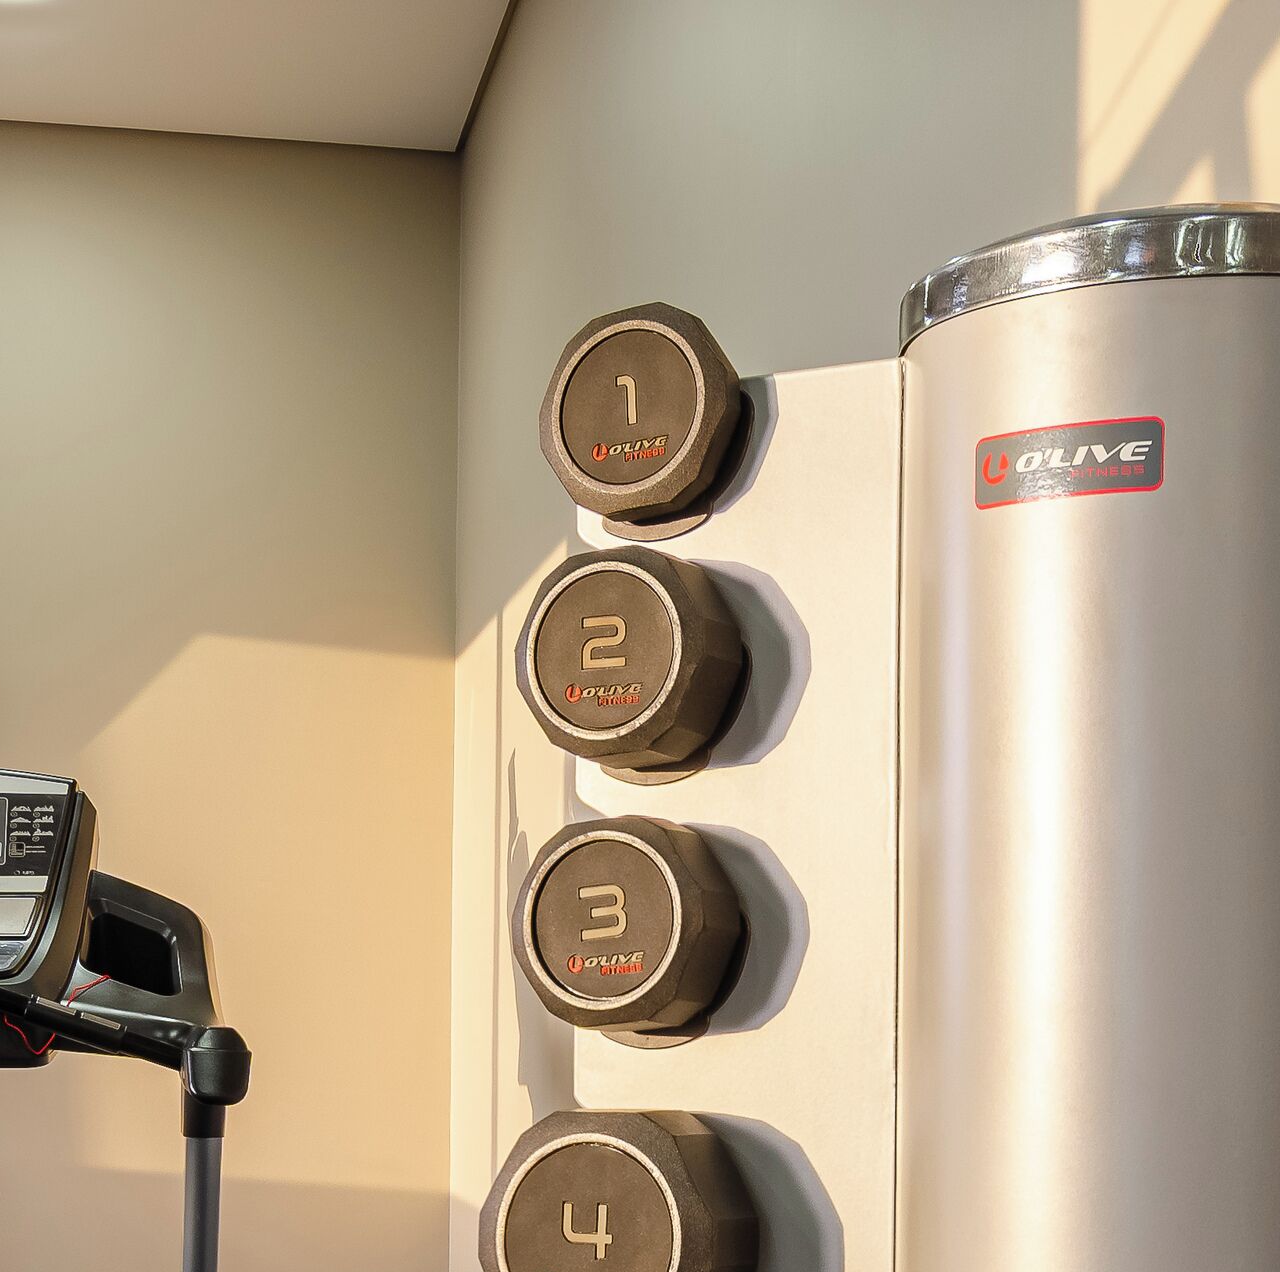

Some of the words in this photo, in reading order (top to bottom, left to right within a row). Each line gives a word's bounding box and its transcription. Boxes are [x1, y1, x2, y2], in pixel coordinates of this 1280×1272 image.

[615, 375, 638, 425] 1
[609, 435, 668, 455] O'LIVE
[1015, 440, 1153, 473] O'LIVE
[581, 614, 627, 670] 2
[582, 683, 643, 698] O'LIVE
[579, 884, 627, 941] 3
[584, 951, 645, 968] O'LIVE
[562, 1202, 613, 1260] 4
